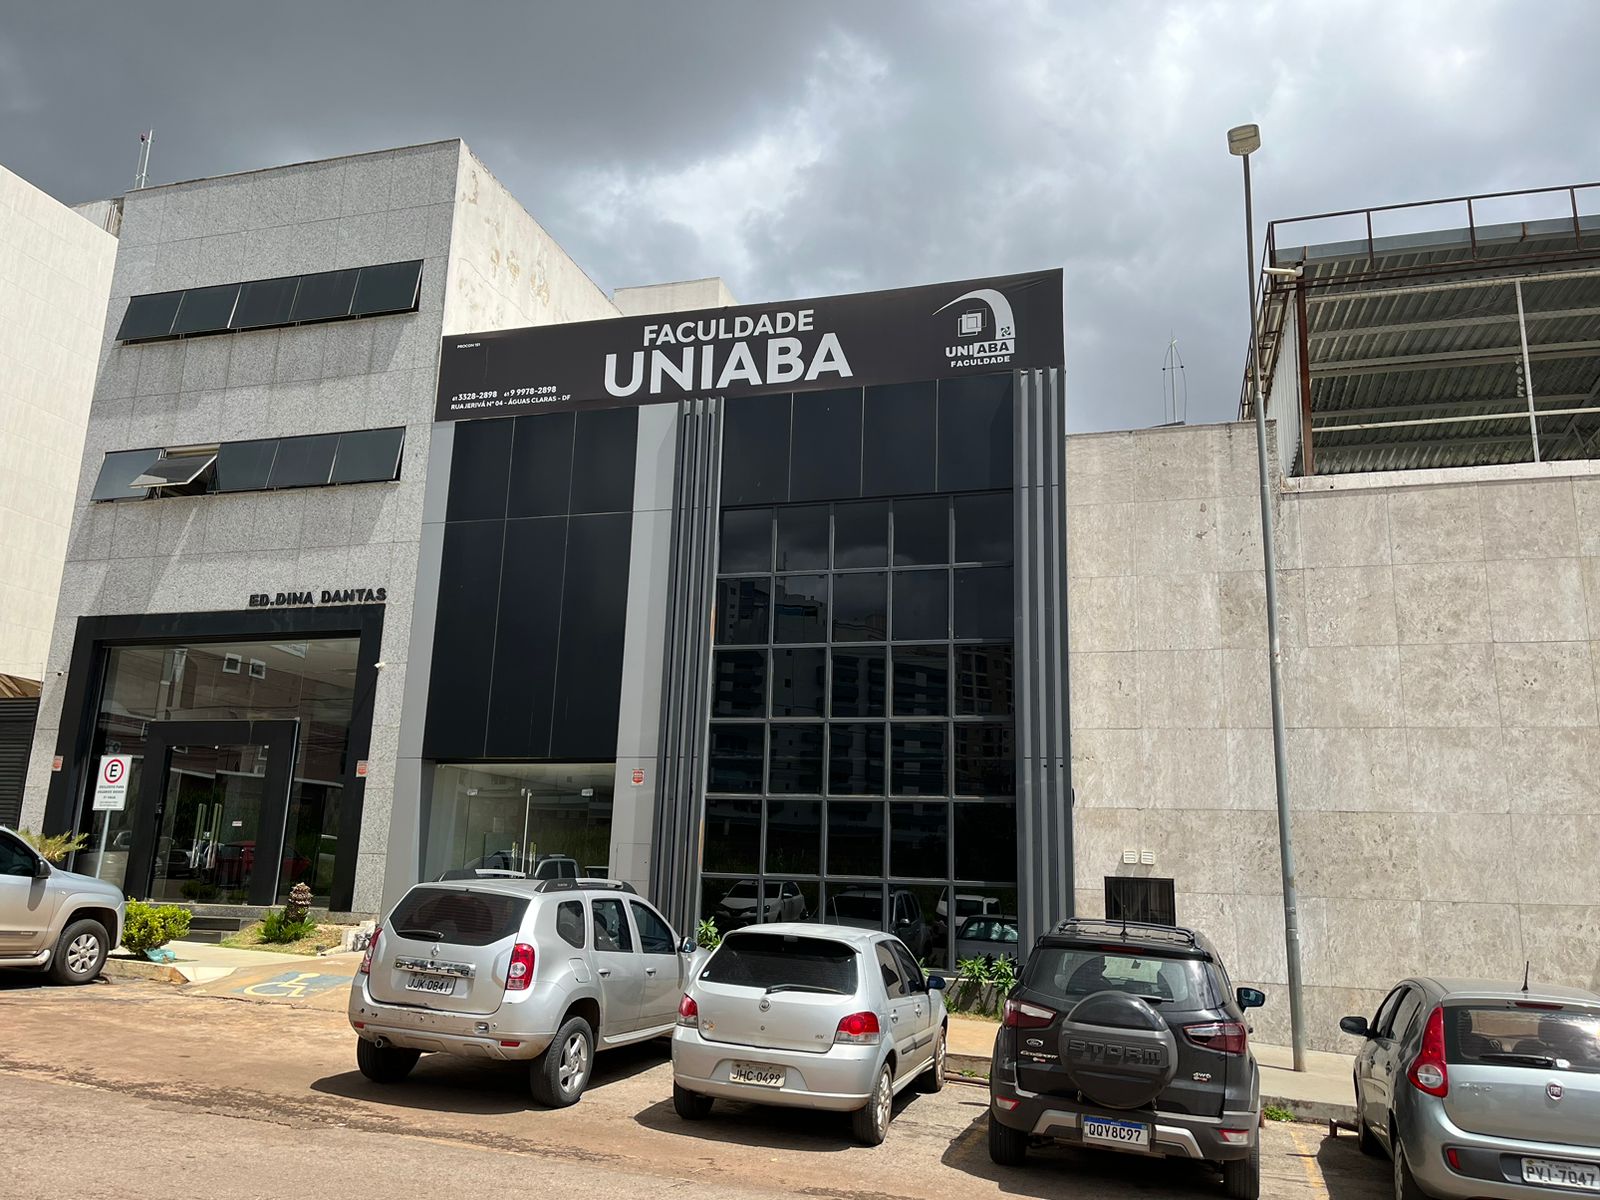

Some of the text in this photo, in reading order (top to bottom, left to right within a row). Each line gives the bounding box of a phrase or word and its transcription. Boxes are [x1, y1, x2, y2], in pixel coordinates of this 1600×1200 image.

[643, 309, 814, 346] FACULDADE
[945, 342, 1010, 358] UNIABA
[604, 332, 853, 397] UNIABA
[950, 355, 1010, 368] FACULDADE
[508, 398, 530, 406] ÁGUAS
[531, 395, 557, 403] CLARAS
[320, 587, 387, 603] DANTAS
[109, 763, 119, 777] E
[1068, 1039, 1161, 1065] STORM
[1089, 1123, 1142, 1142] QQY8C97
